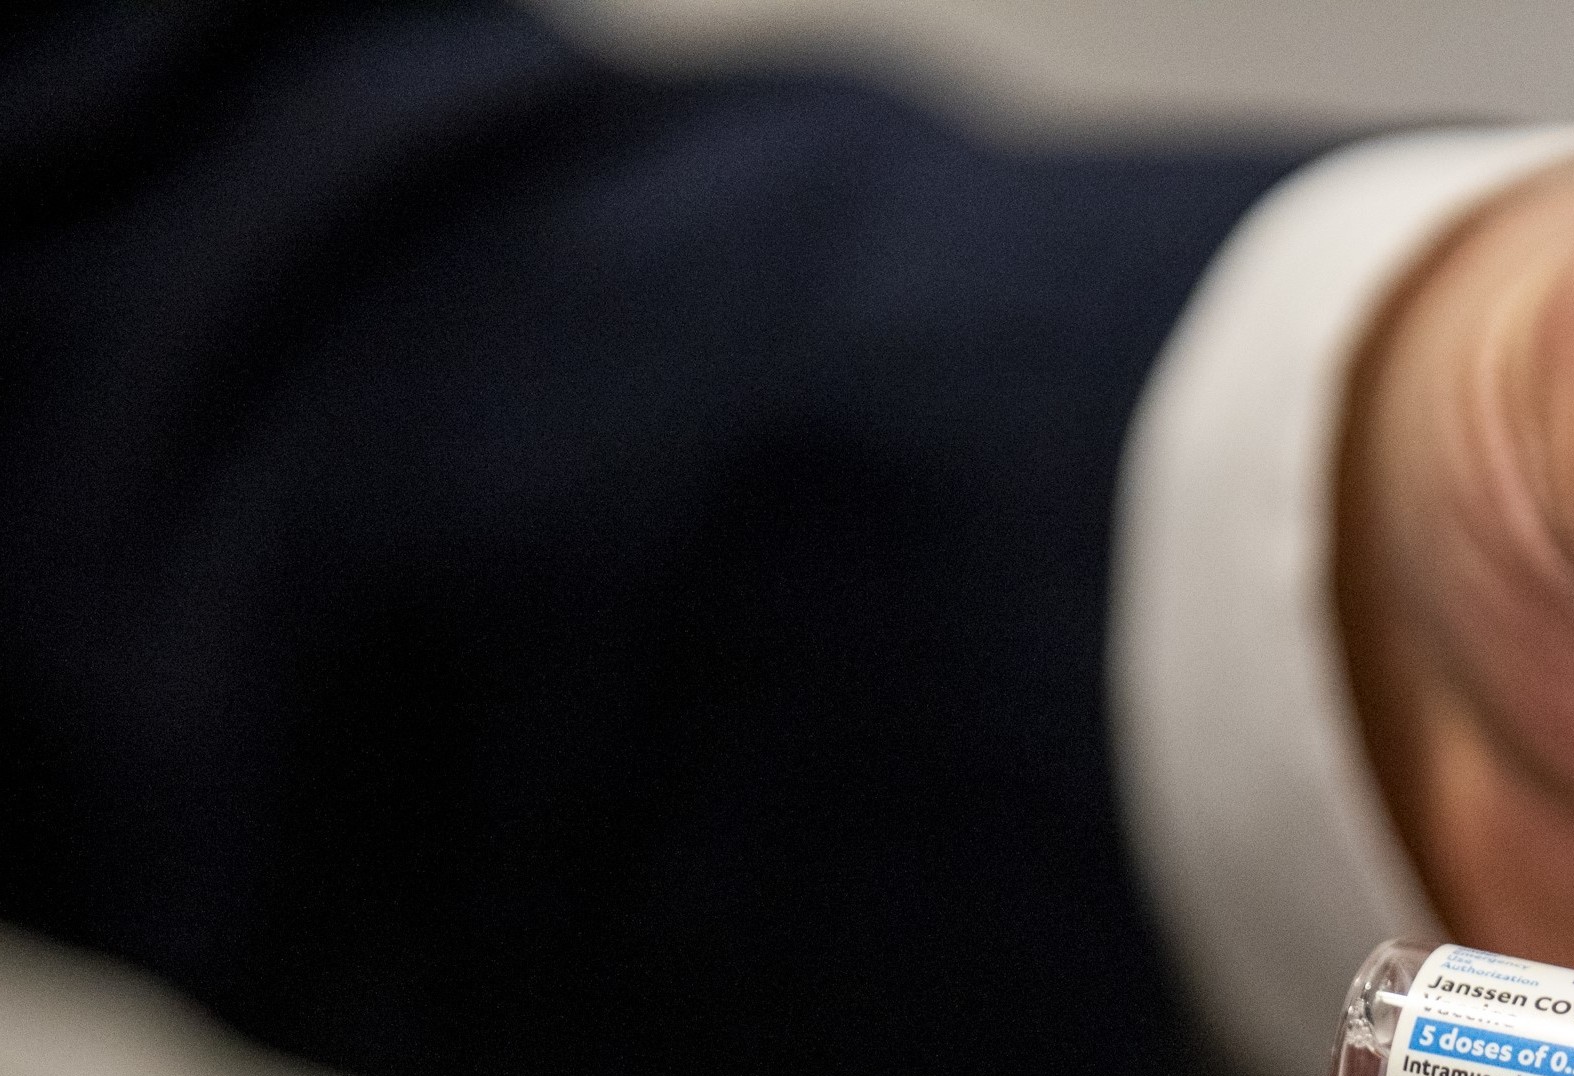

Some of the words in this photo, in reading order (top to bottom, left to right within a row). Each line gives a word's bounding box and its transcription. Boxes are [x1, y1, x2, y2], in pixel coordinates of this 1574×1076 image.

[1441, 961, 1539, 986] Authorization
[1428, 976, 1527, 1007] Janssen
[1419, 1024, 1437, 1046] 5
[1439, 1027, 1513, 1062] doses
[1518, 1045, 1549, 1068] of
